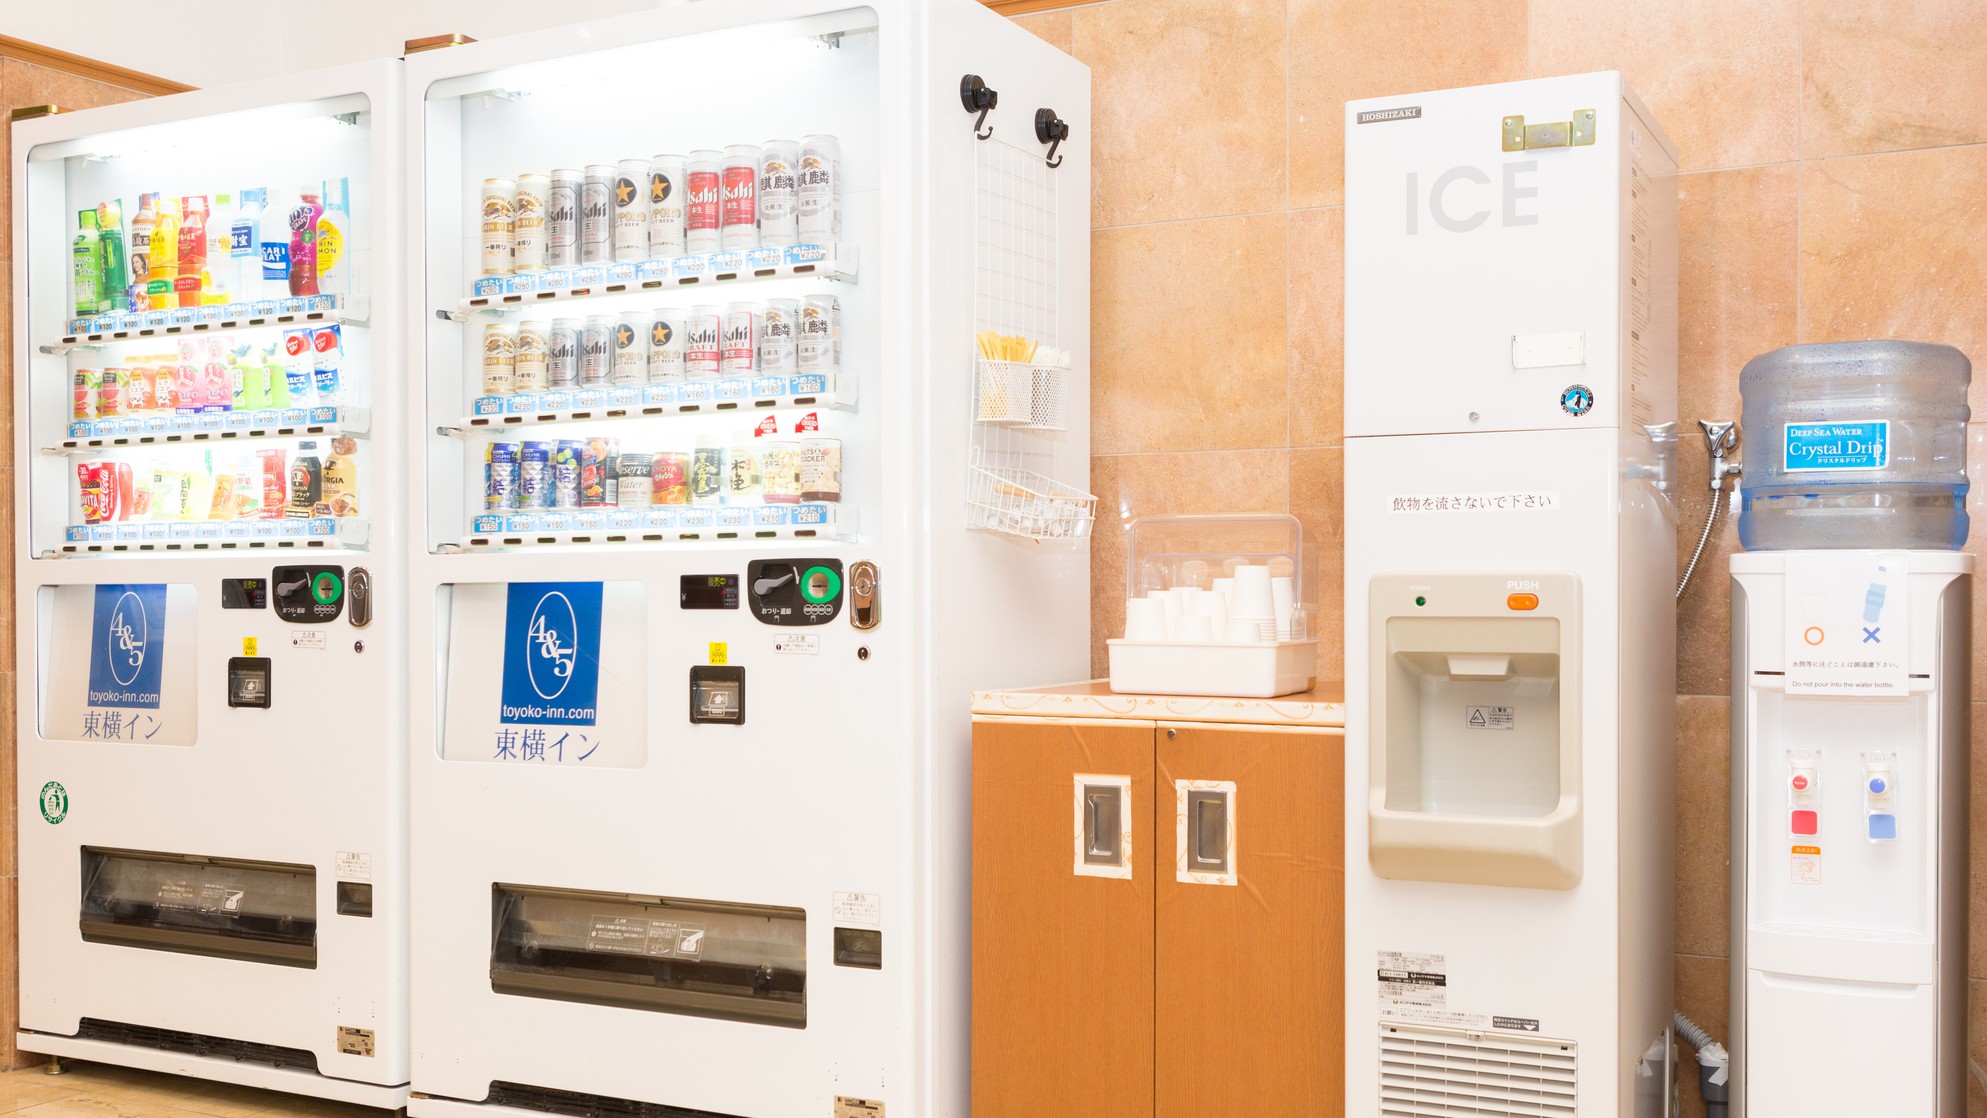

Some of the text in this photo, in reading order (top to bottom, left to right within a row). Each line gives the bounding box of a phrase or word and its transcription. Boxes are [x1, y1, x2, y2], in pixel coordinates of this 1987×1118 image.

[1362, 108, 1417, 122] HOSHIZAKI
[1405, 160, 1539, 235] ICE
[507, 276, 535, 284] つめたい
[280, 298, 305, 306] つめたい
[752, 377, 786, 386] つめたい
[791, 376, 824, 385] つめたい
[1789, 440, 1883, 460] Crystal Drip
[1392, 494, 1552, 511] 飲物を流さないで下さい
[792, 506, 827, 514] つめたい
[309, 519, 334, 527] つめたい
[1507, 580, 1539, 590] PUSH
[111, 612, 144, 666] 4&5
[530, 615, 573, 677] 4&5
[90, 690, 159, 704] toyoko-inn.com
[503, 705, 594, 721] toyoko-inn.com
[81, 710, 163, 740] 東横イン
[492, 728, 600, 762] 東横イン
